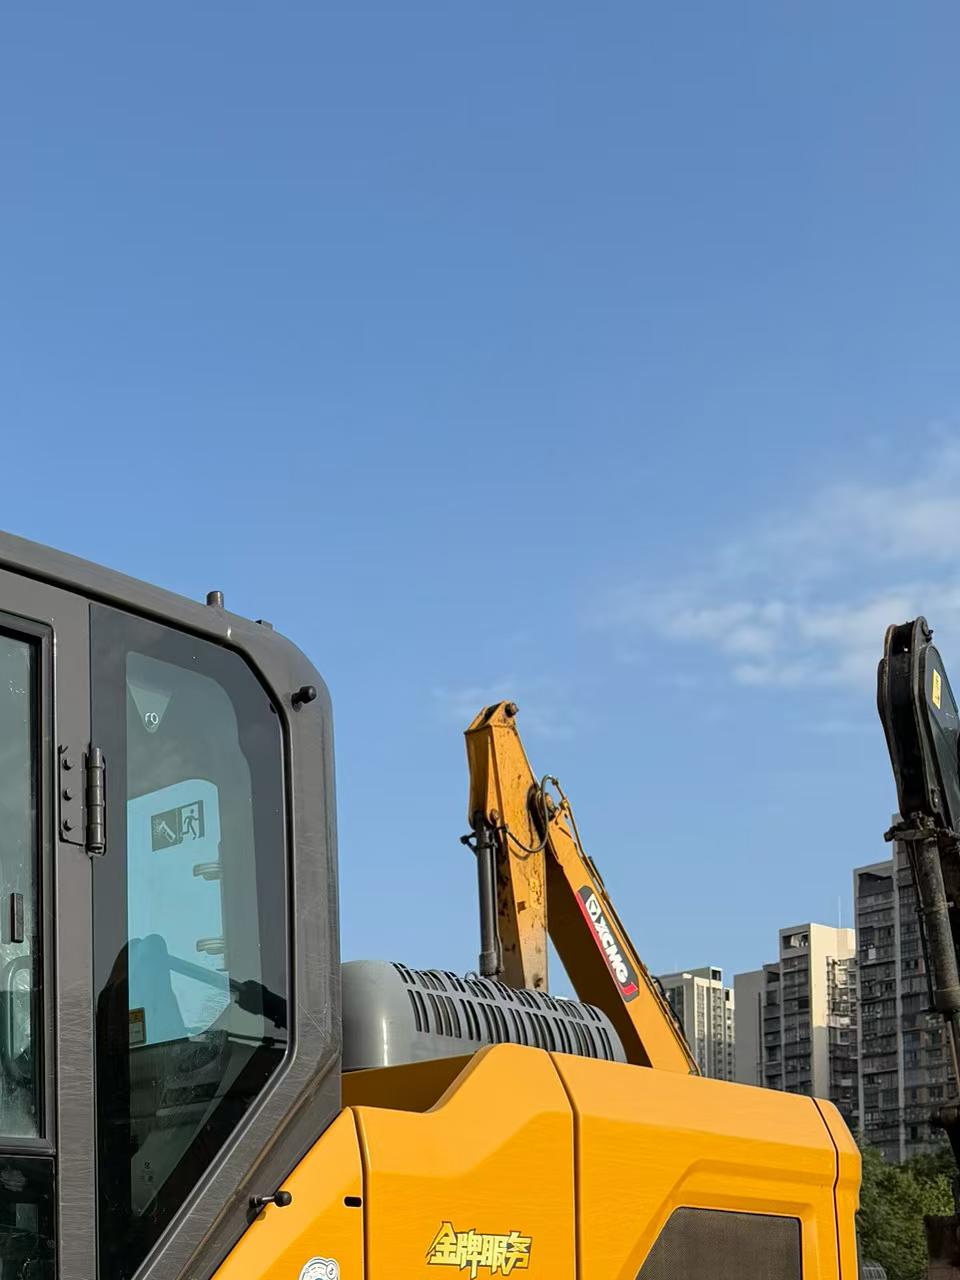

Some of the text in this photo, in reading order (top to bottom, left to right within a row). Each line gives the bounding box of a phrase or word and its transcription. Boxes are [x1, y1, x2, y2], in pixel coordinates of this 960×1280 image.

[593, 915, 628, 983] XCMG
[425, 1220, 532, 1280] 金牌服务
